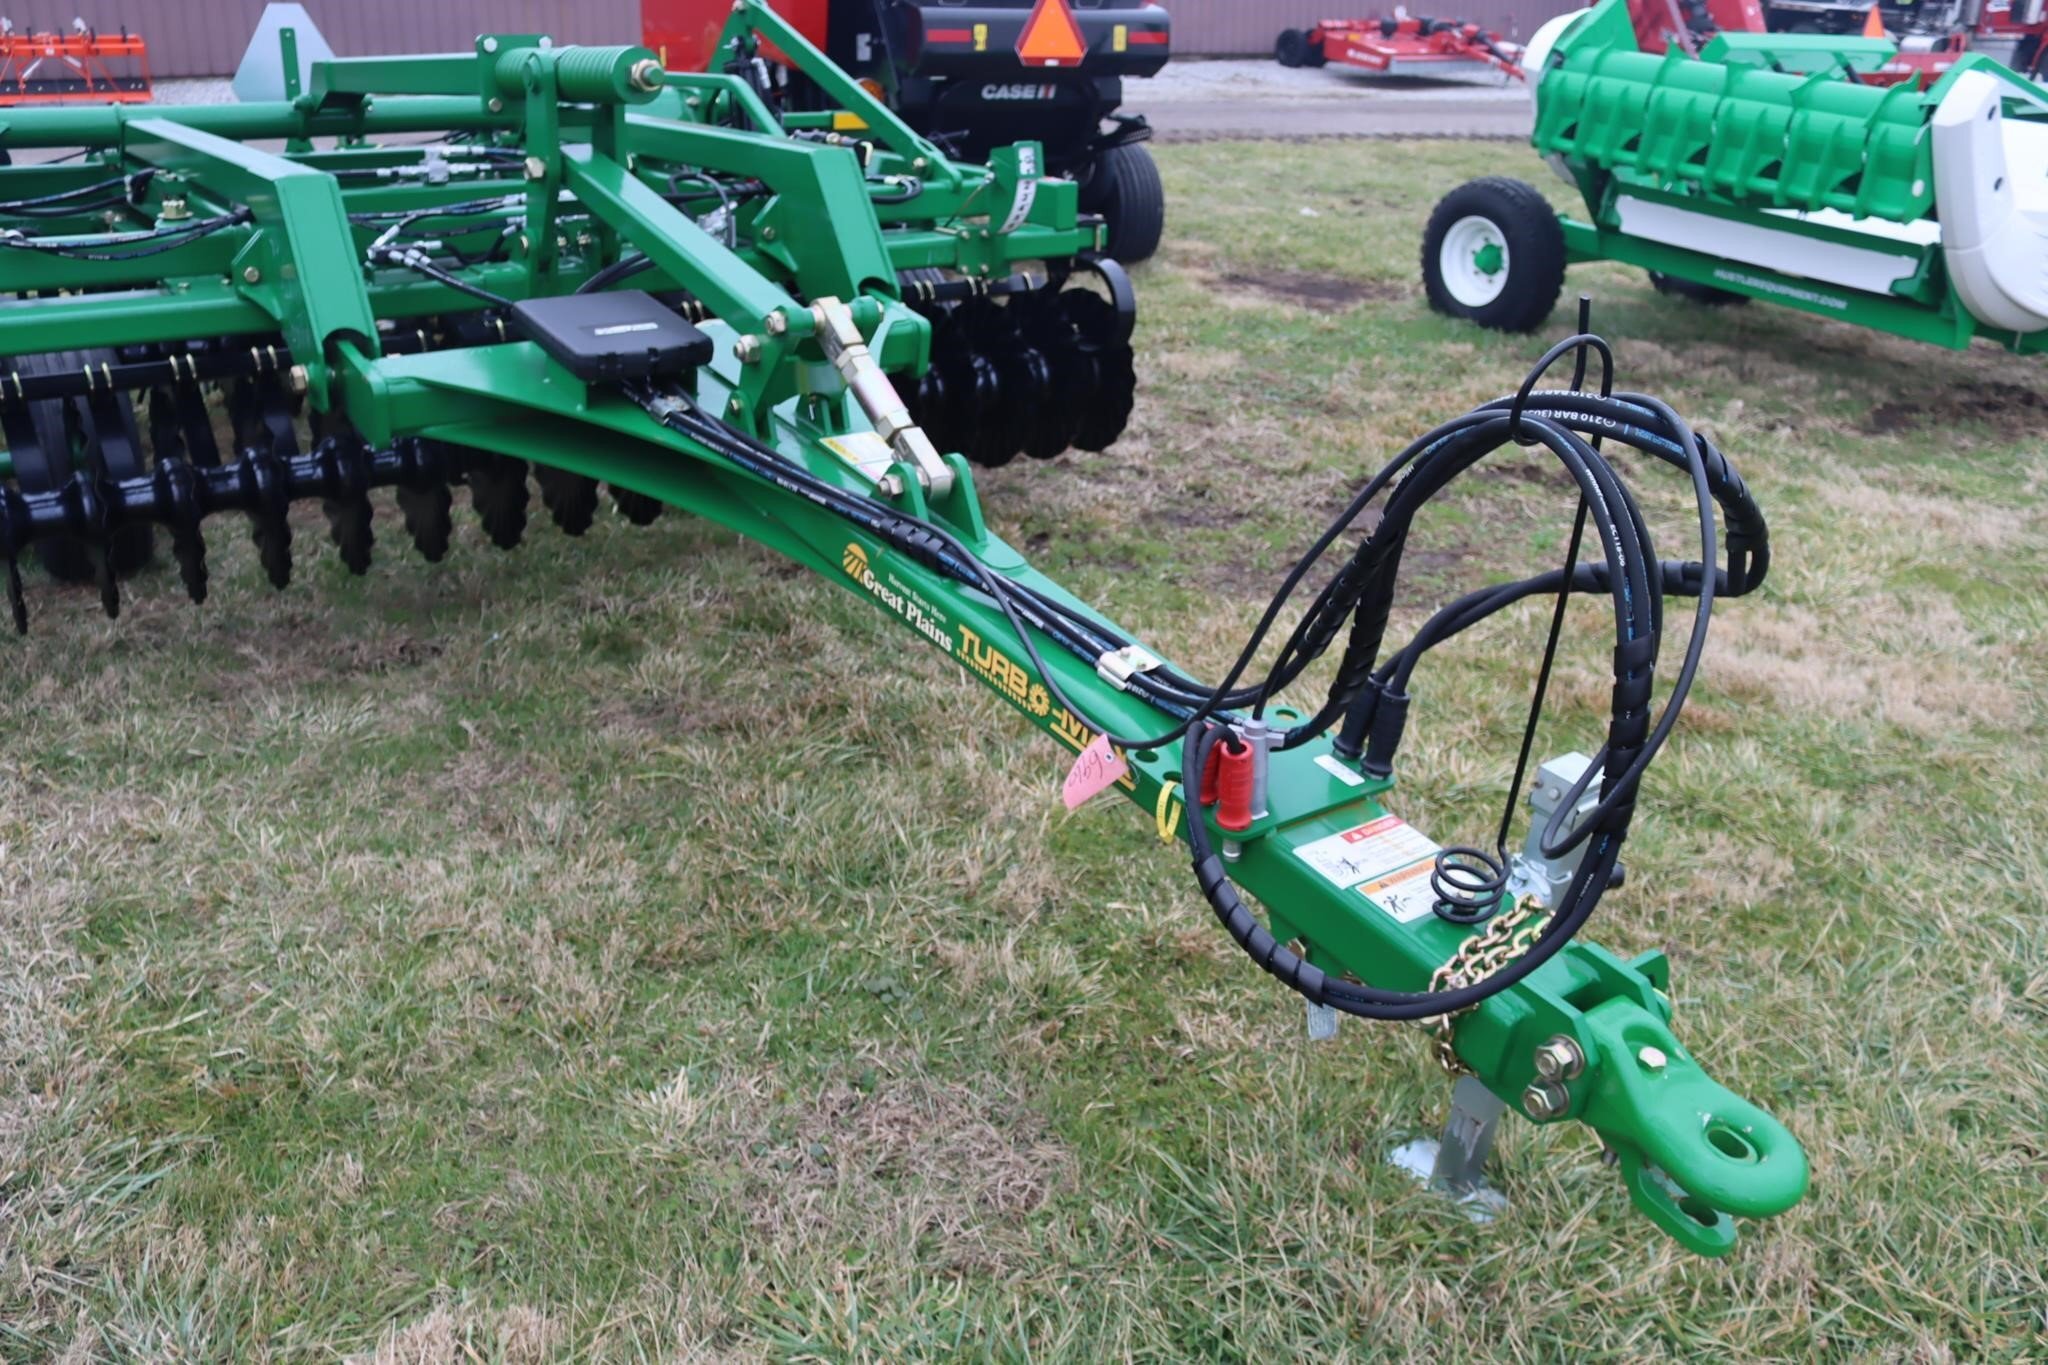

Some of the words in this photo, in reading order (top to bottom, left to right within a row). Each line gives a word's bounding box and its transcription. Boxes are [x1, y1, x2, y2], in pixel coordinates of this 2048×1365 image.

[981, 84, 1037, 100] CASE
[1554, 409, 1579, 420] BAR
[1580, 411, 1603, 425] 210
[862, 568, 904, 614] Great
[905, 600, 953, 652] Plains
